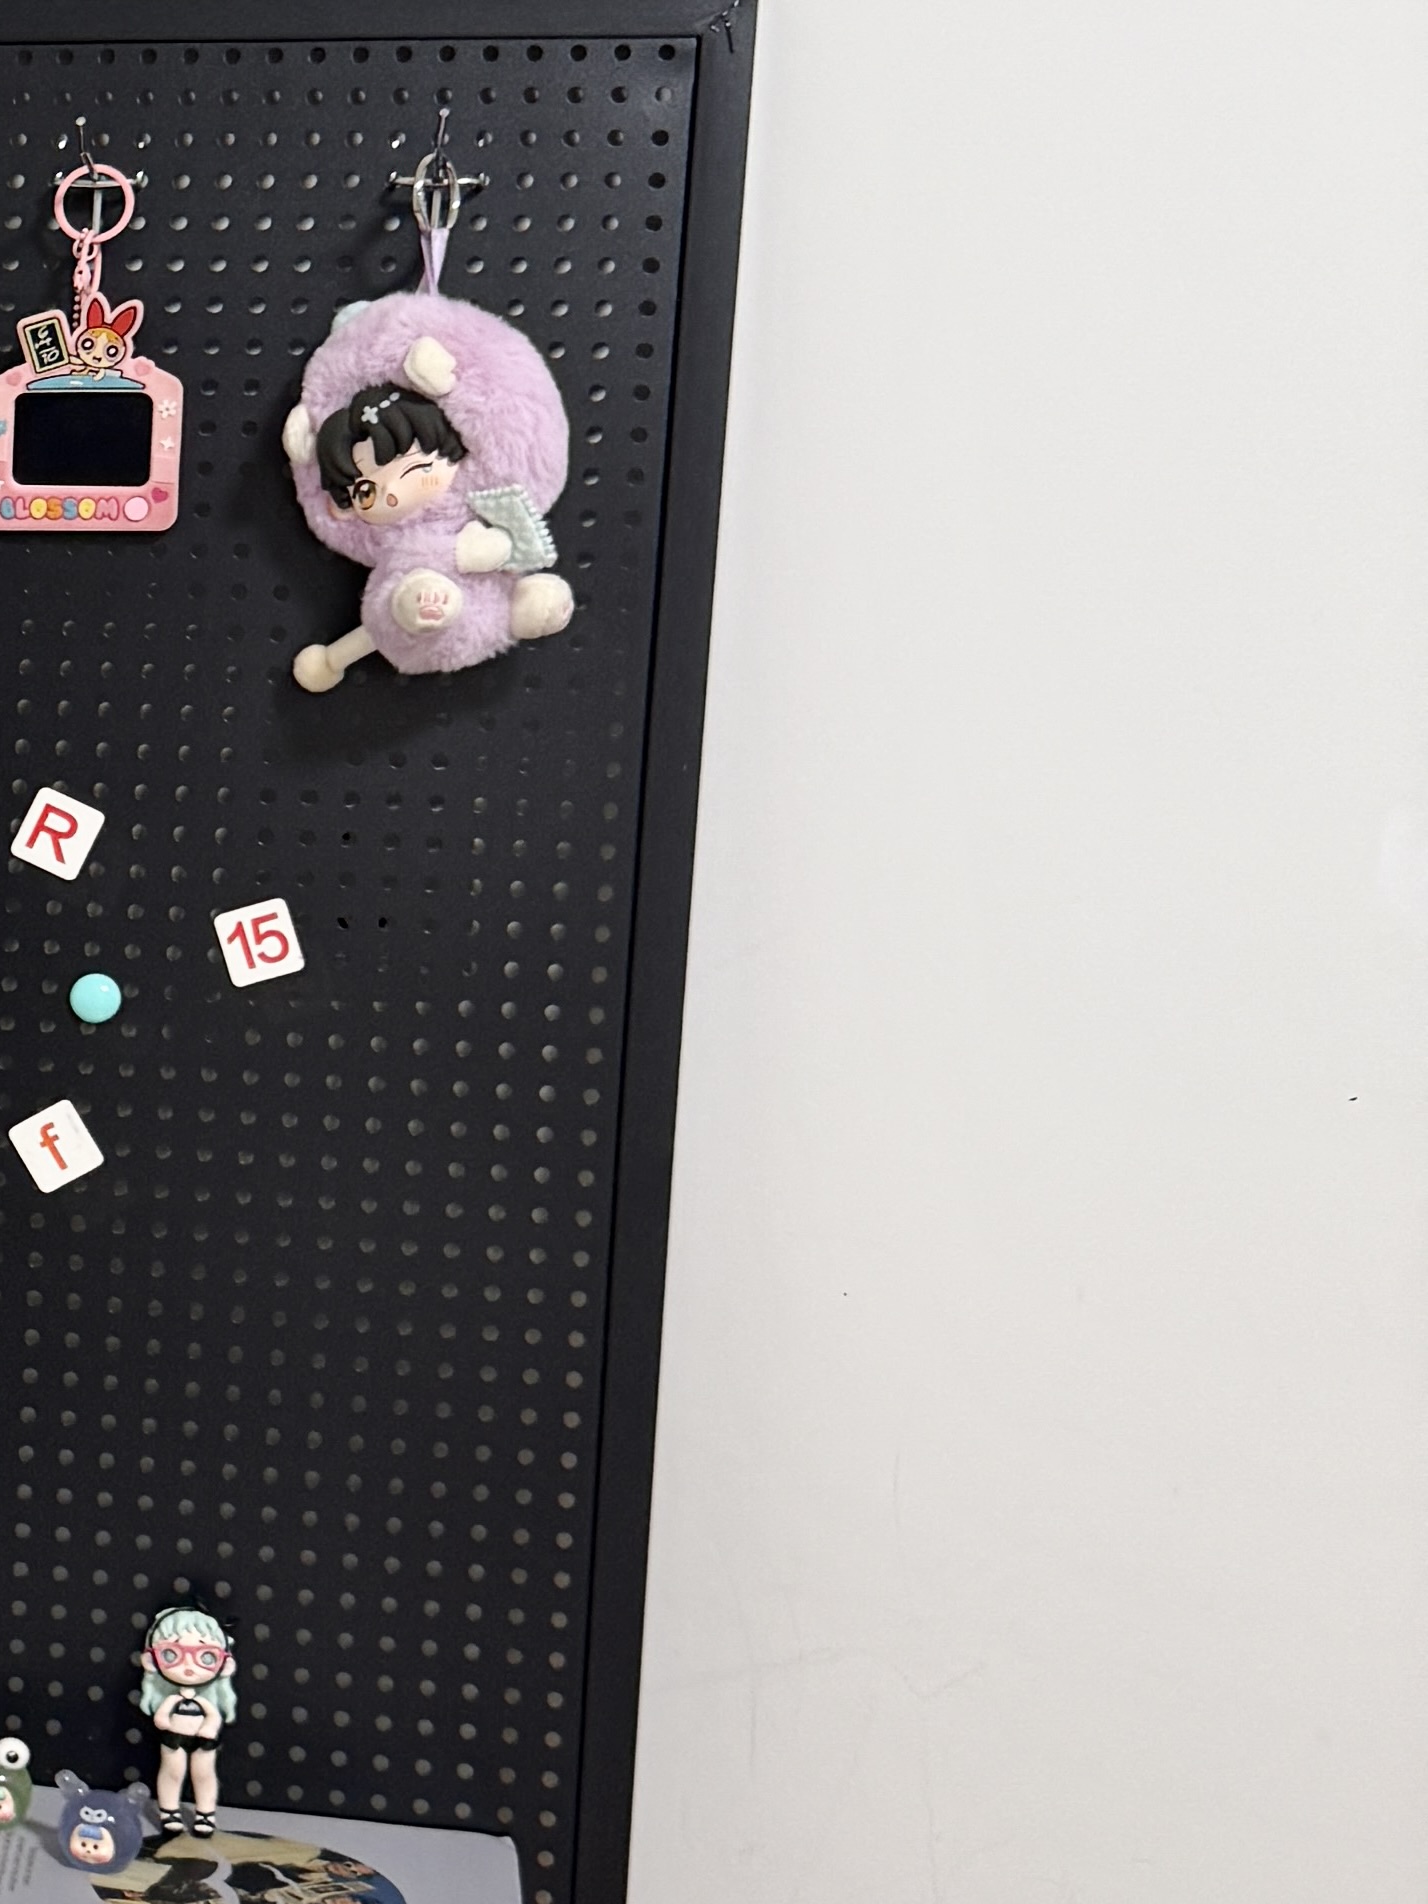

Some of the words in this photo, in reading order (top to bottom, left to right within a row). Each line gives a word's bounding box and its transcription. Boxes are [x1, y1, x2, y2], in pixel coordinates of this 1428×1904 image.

[26, 803, 78, 863] R
[227, 913, 289, 969] 15
[40, 1122, 67, 1170] f
